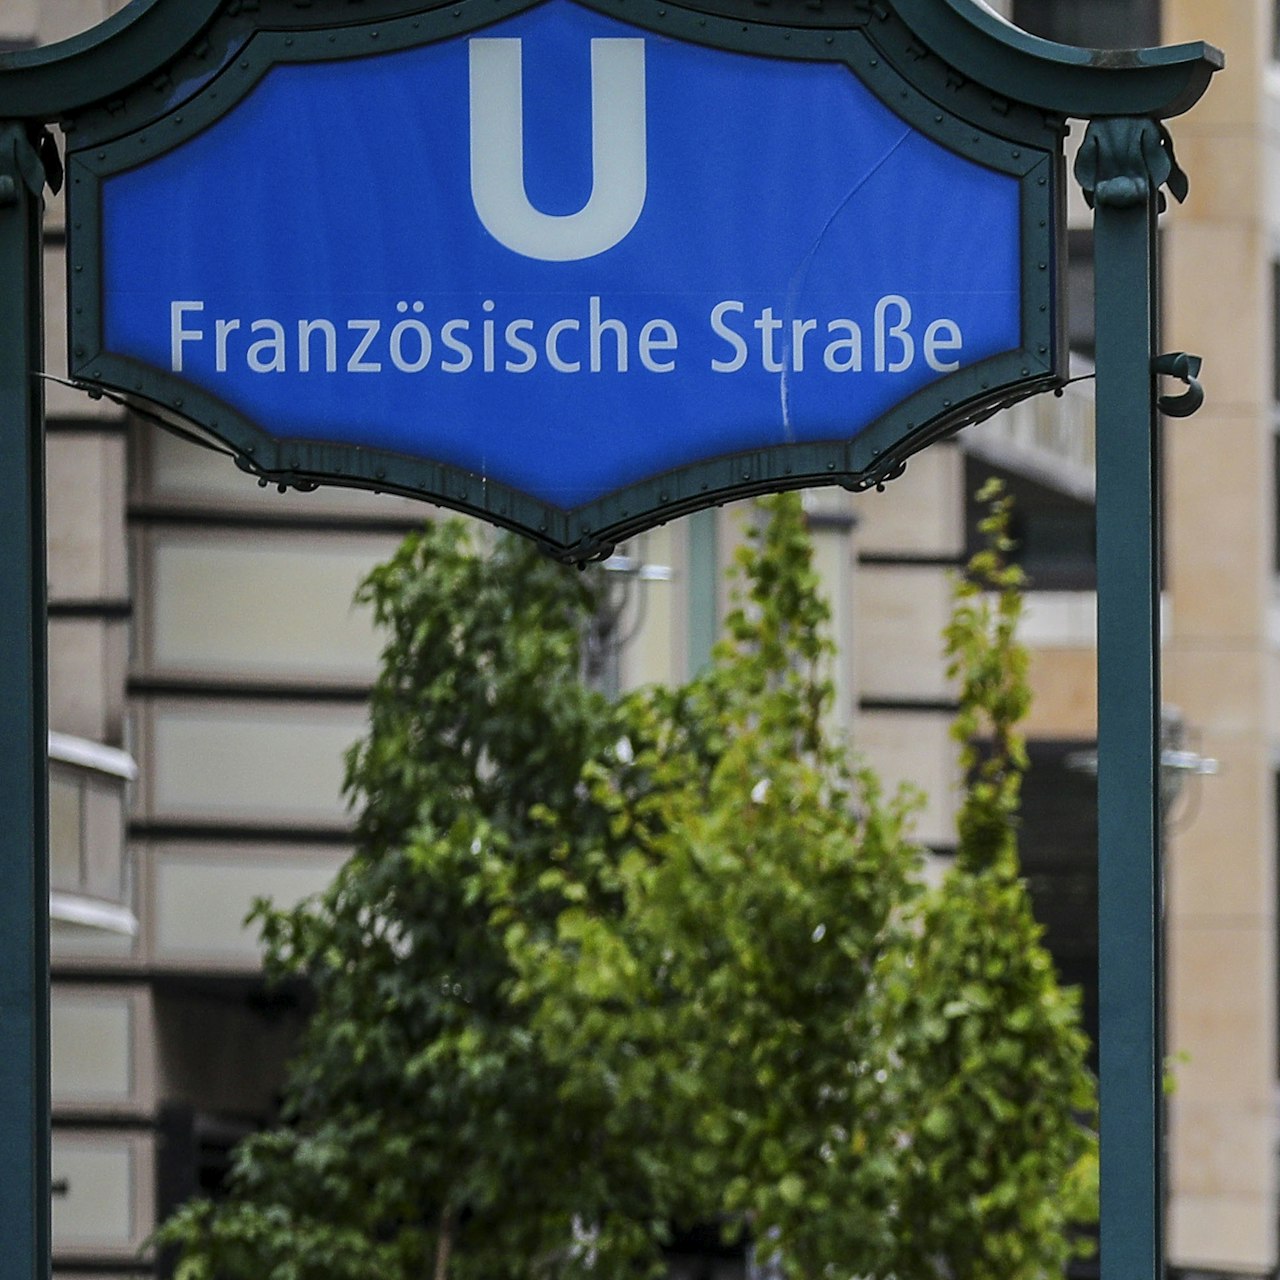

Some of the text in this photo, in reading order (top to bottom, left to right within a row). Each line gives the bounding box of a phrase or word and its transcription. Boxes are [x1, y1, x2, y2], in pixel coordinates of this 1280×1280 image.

[468, 37, 647, 261] U
[170, 294, 963, 373] Französische Straße
